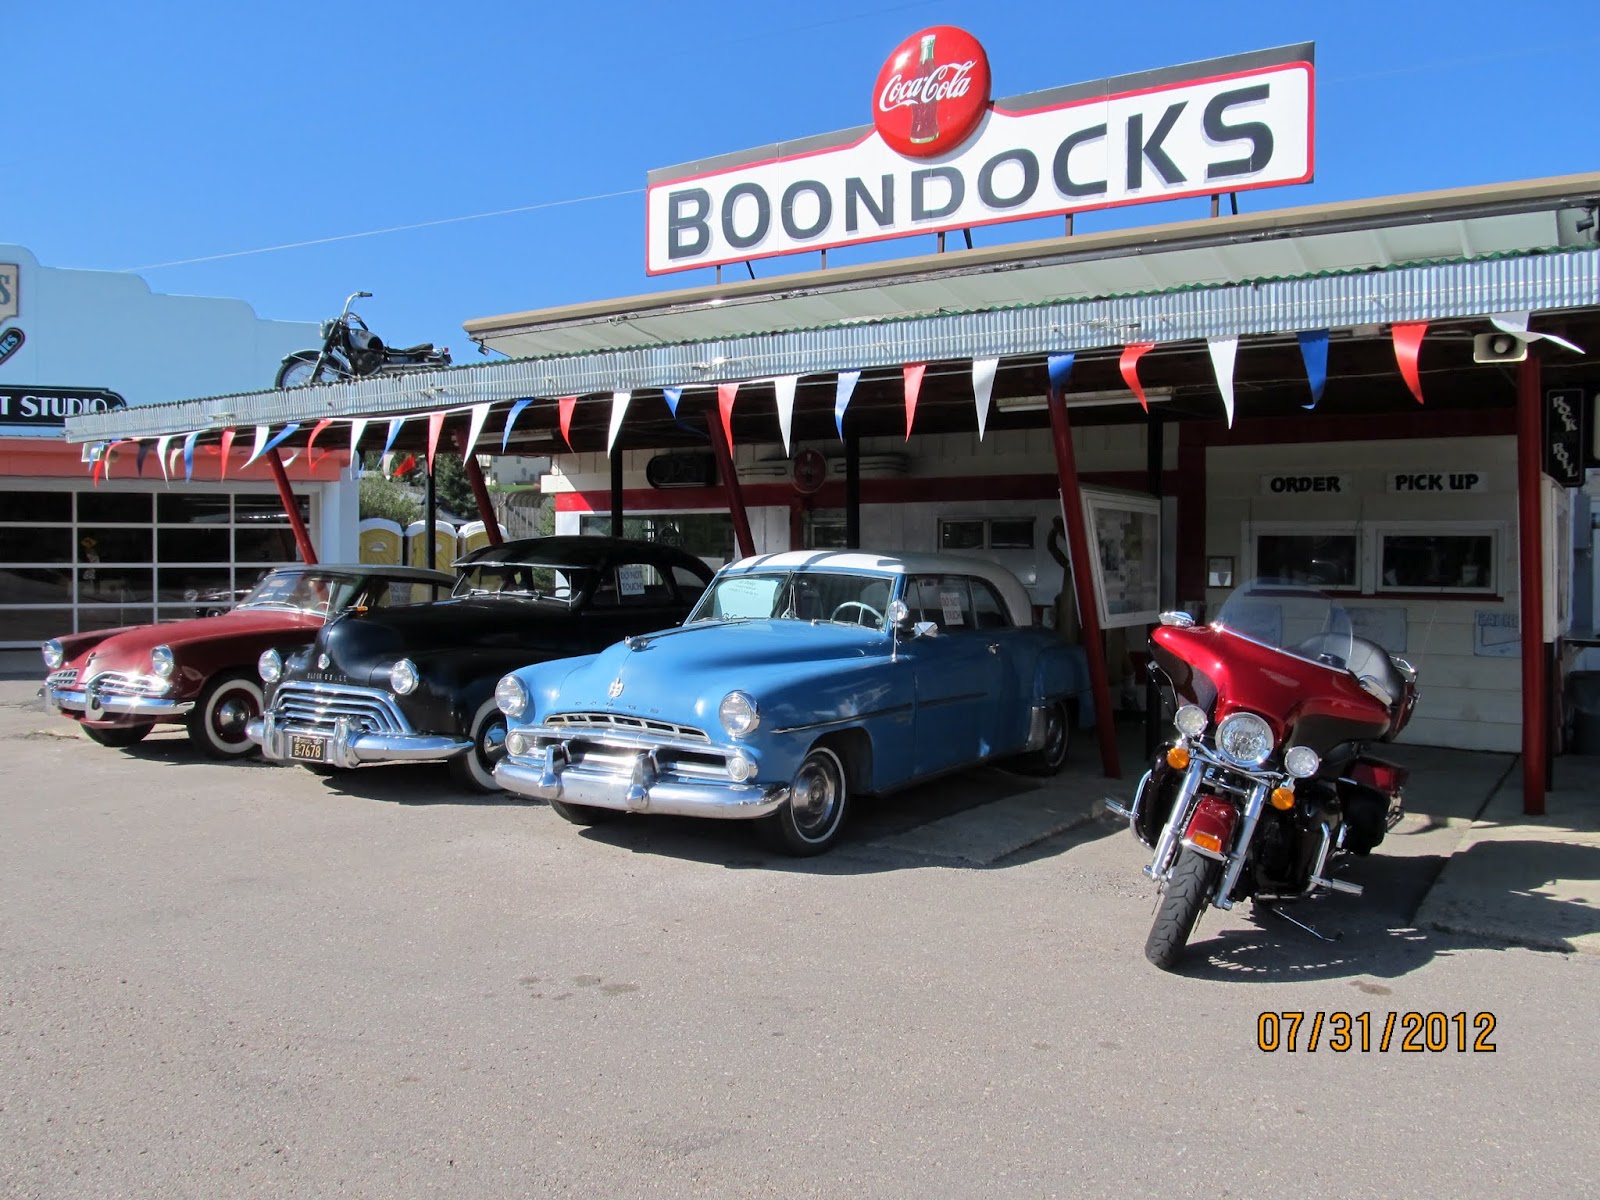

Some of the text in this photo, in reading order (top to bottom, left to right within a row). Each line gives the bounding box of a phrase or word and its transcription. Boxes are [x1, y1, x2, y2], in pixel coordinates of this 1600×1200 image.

[668, 83, 1275, 261] BOONDOCKS
[20, 395, 108, 417] STUDIO
[1552, 396, 1579, 432] ROCK
[1552, 442, 1579, 478] ROLL
[1270, 476, 1341, 493] ORDER
[1395, 474, 1479, 491] PICK UP
[620, 571, 630, 580] DO
[300, 744, 321, 758] 7678
